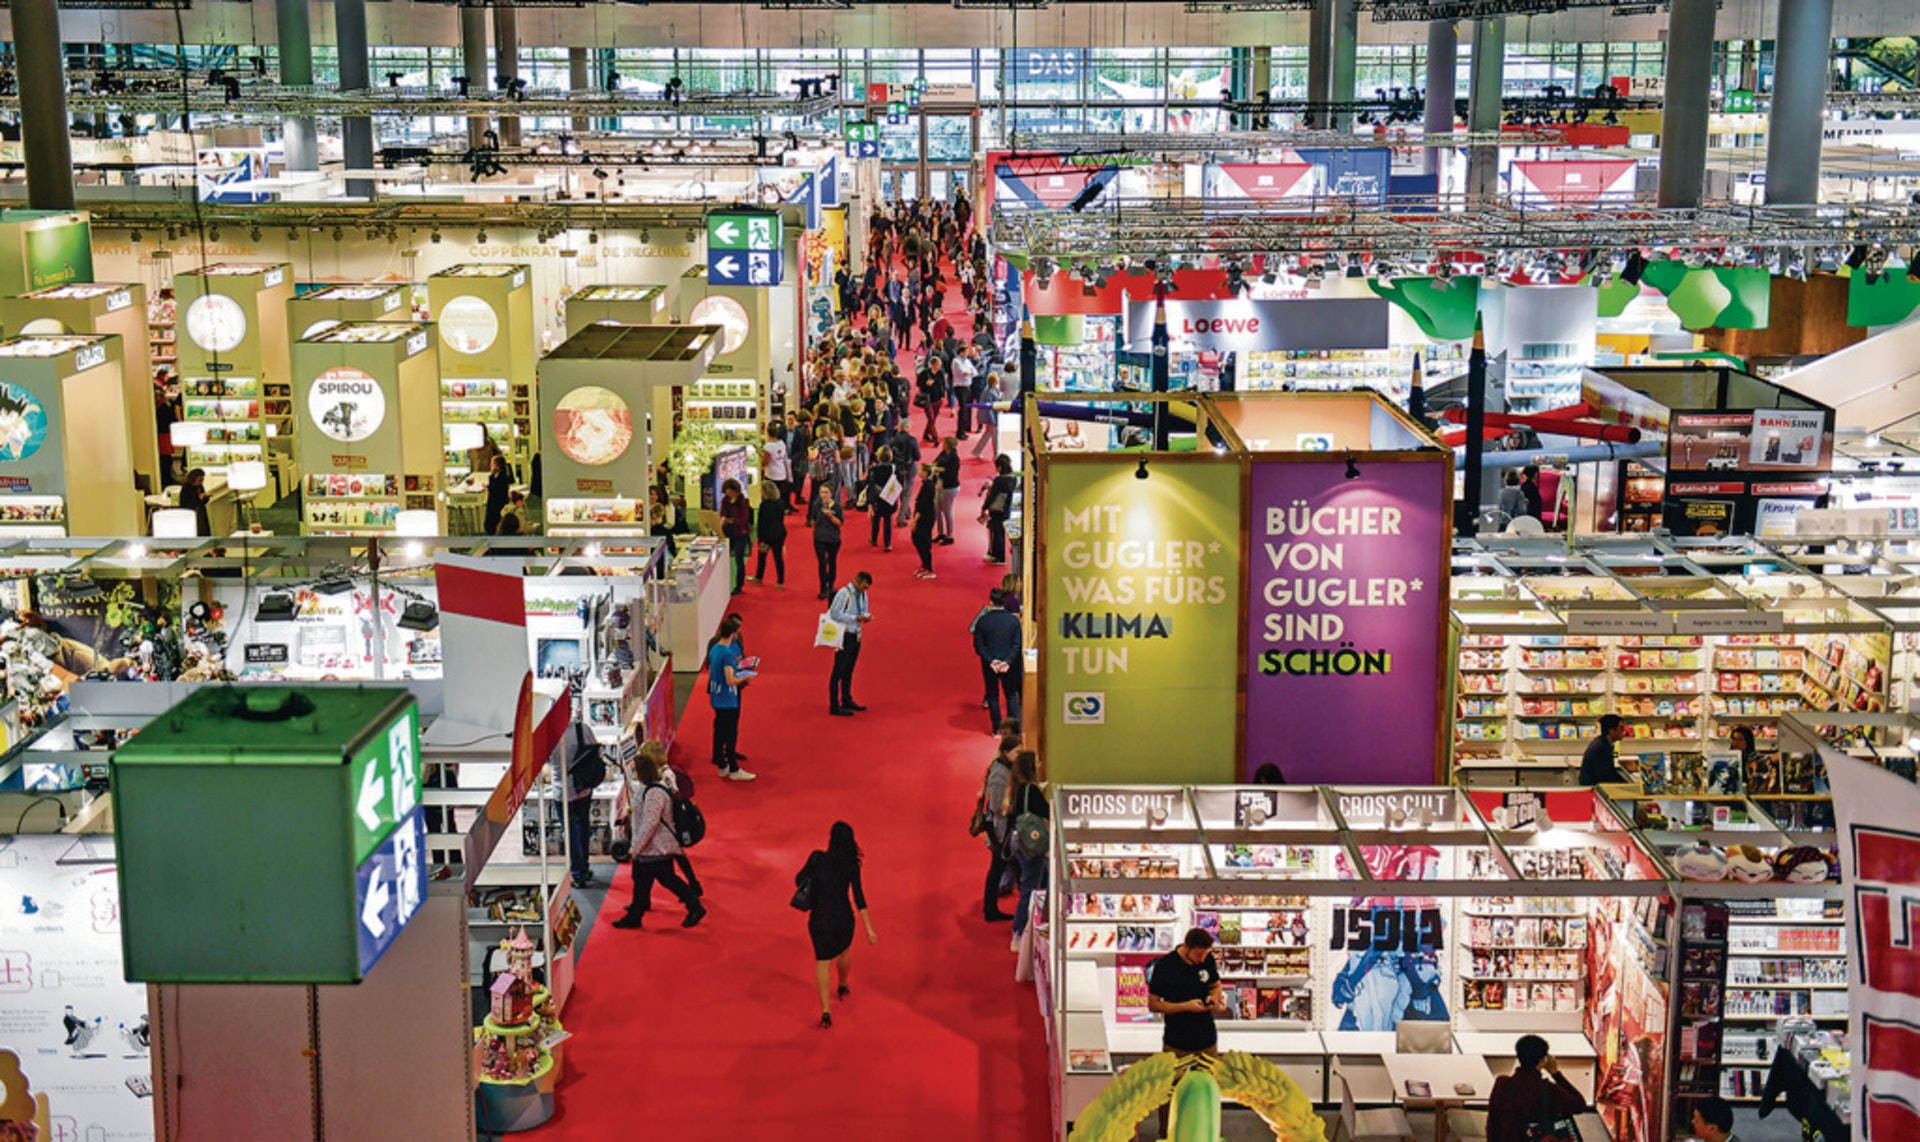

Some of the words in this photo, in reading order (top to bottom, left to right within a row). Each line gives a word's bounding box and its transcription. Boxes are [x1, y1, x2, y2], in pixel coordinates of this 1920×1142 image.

[1029, 52, 1075, 75] DAS
[318, 382, 373, 395] SPIROU
[1760, 418, 1818, 429] BAHNSINN
[1063, 505, 1122, 534] MIT
[1266, 500, 1402, 535] BÜCHER
[1264, 542, 1344, 571] VON
[1062, 576, 1137, 605] WAS
[1145, 569, 1227, 605] FÜRS
[1063, 612, 1169, 639] KLIMA
[1263, 613, 1344, 642] SIND
[1062, 646, 1129, 675] TUN
[1263, 641, 1386, 676] SCHÖN
[1068, 794, 1127, 815] CROSS
[1339, 795, 1397, 817] CROSS
